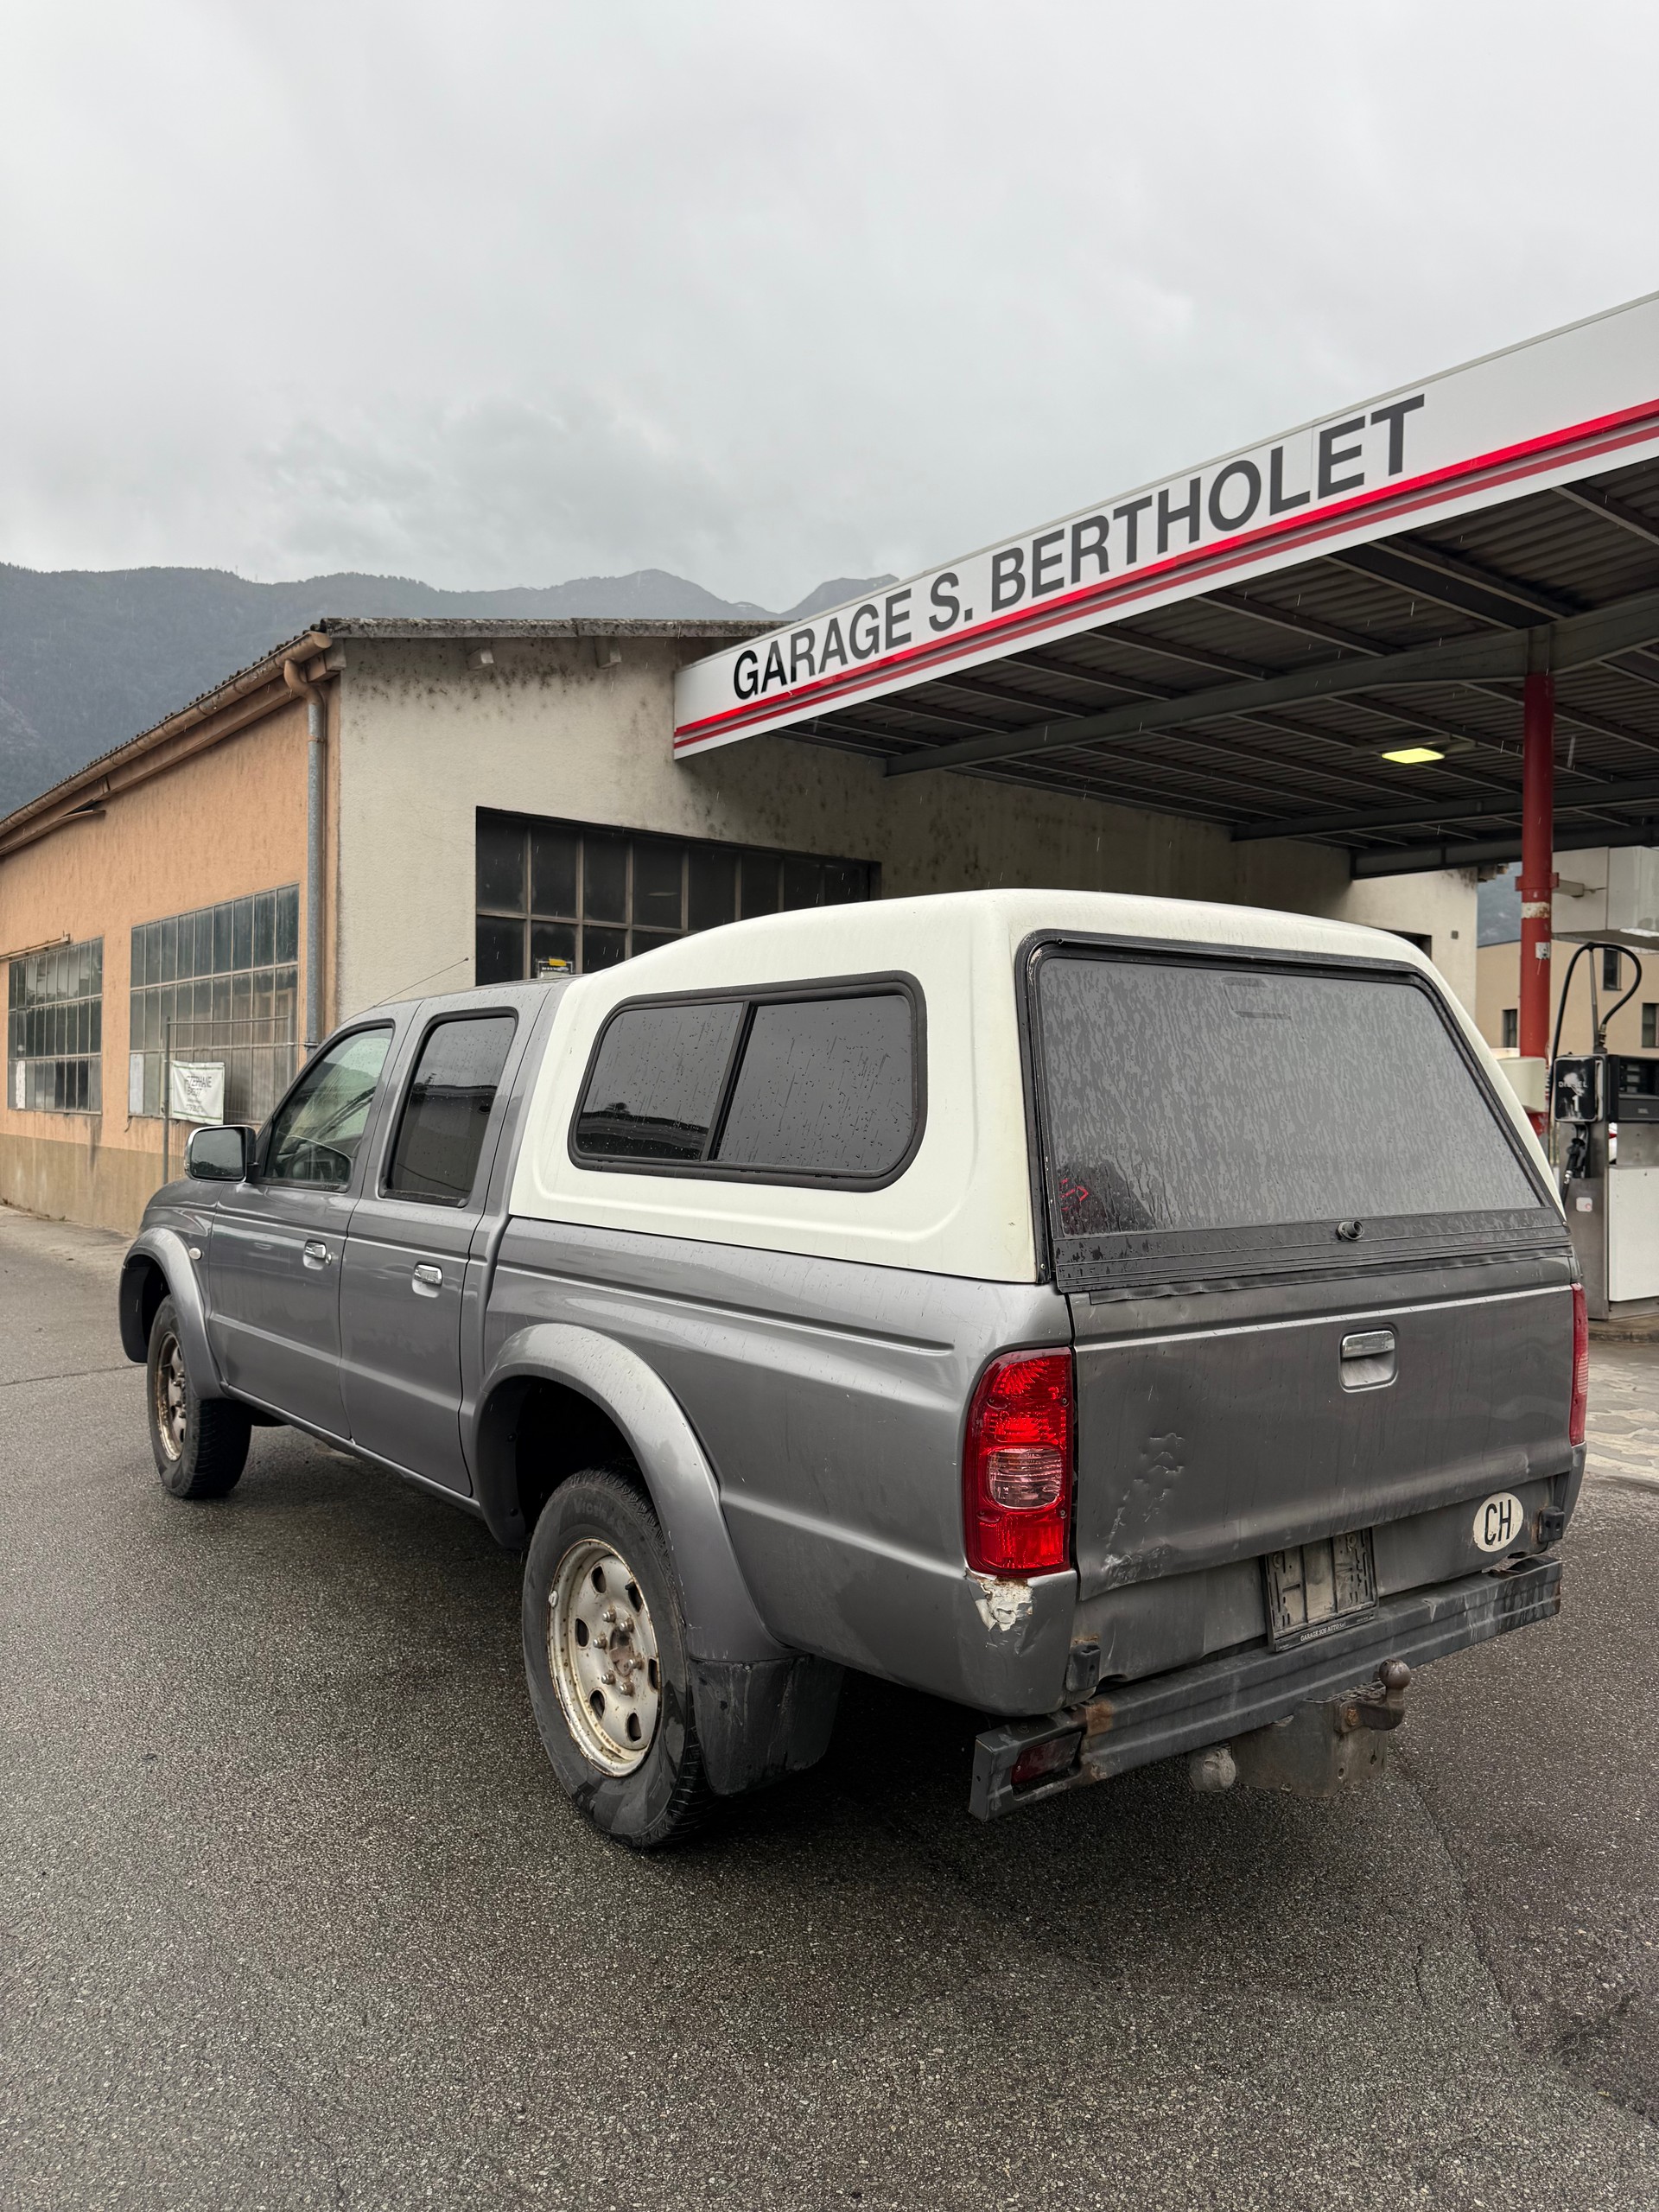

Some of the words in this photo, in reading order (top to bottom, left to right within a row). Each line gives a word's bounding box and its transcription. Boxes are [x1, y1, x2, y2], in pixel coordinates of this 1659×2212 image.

[734, 588, 912, 700] GARAGE
[929, 572, 974, 632] S.
[991, 393, 1425, 613] BERTHOLET
[1558, 1080, 1588, 1089] DISEL
[1572, 1095, 1580, 1113] 1
[1484, 1499, 1511, 1546] CH
[1300, 1630, 1319, 1642] GARAGE
[1327, 1624, 1339, 1632] AUTO
